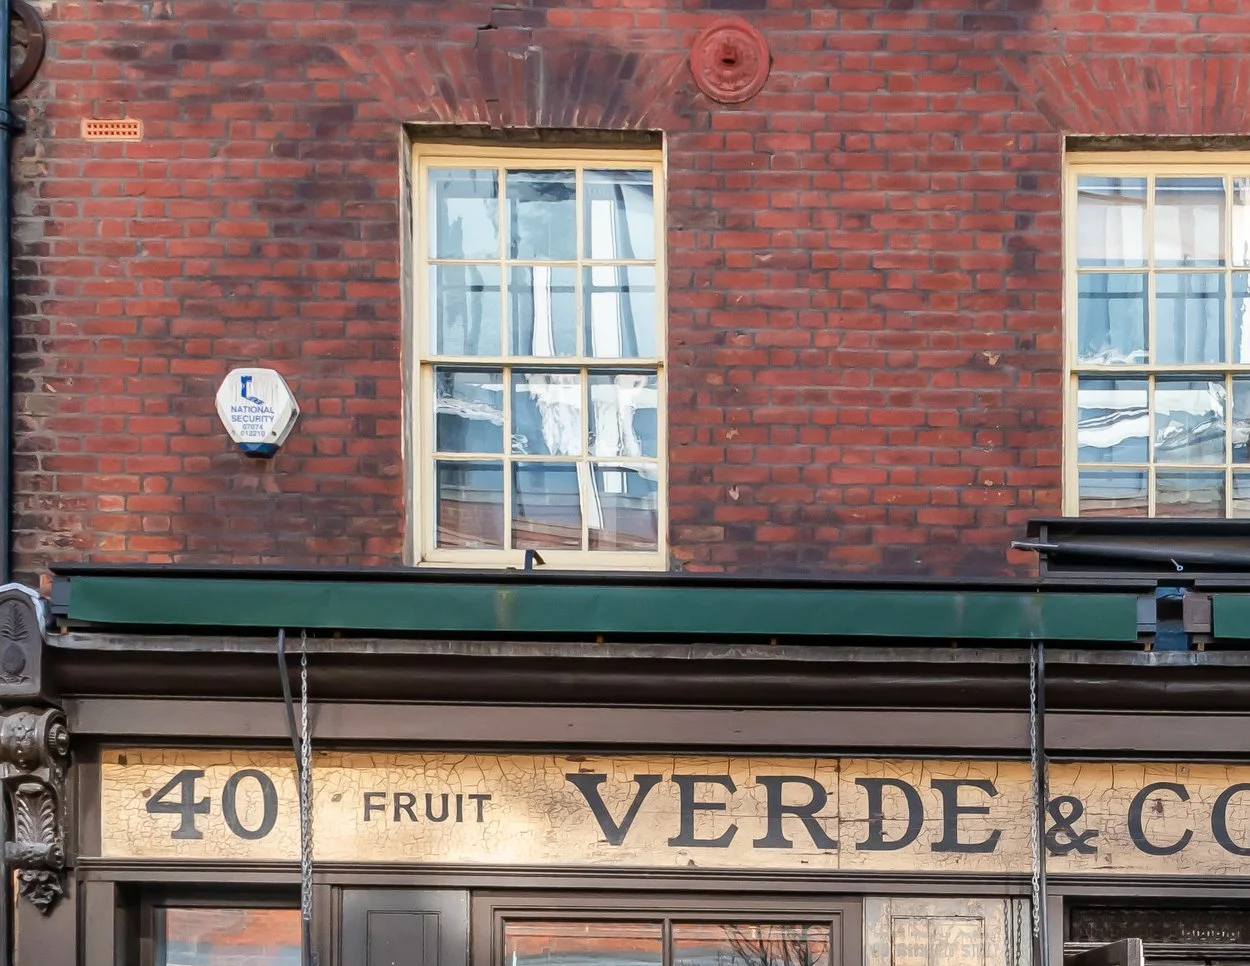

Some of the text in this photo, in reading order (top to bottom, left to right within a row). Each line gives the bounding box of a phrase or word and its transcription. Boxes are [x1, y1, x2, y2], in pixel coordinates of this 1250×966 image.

[231, 405, 275, 414] NATIONAL
[231, 414, 275, 423] SECURITY
[145, 768, 279, 840] 40
[363, 791, 492, 823] FRUIT
[565, 773, 1002, 853] VERDE
[1044, 794, 1099, 857] &
